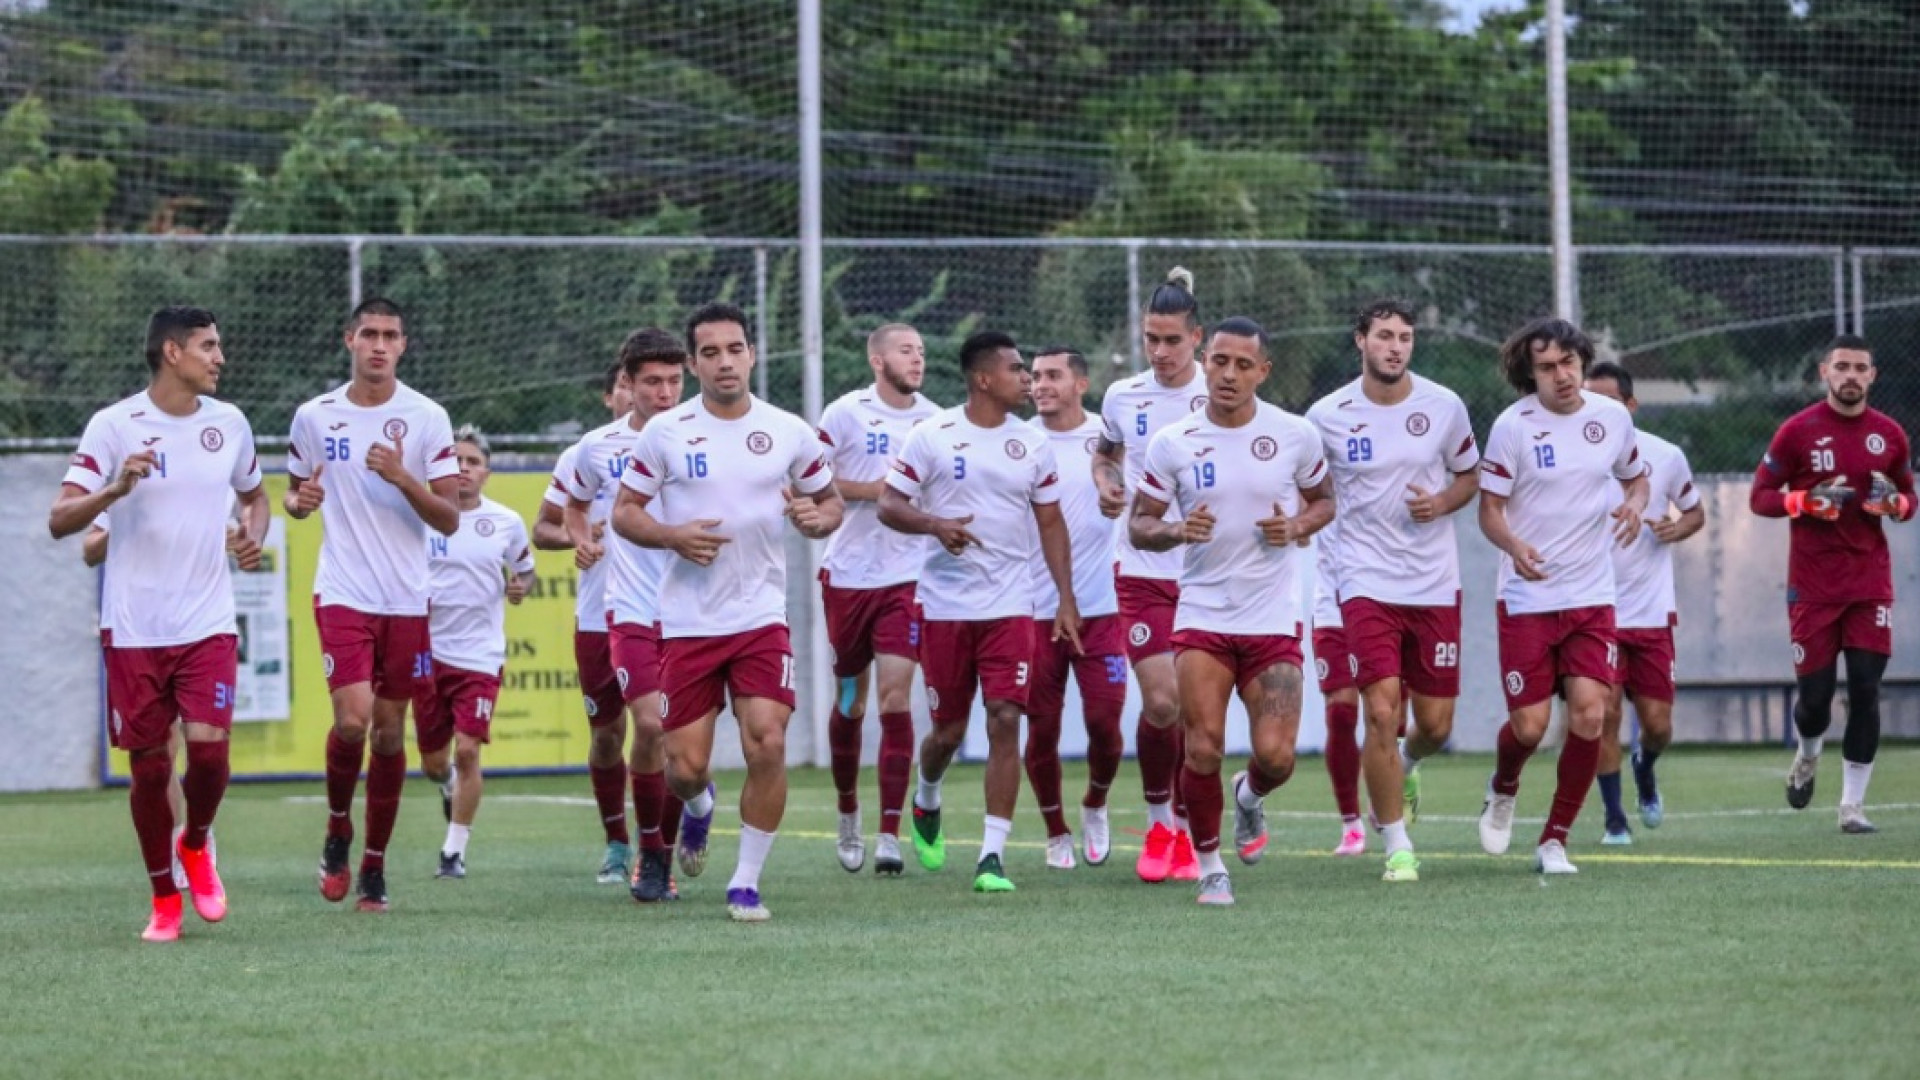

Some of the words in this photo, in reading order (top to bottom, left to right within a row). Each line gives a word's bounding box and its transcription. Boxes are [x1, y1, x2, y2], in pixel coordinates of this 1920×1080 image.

[1136, 413, 1148, 436] 5
[325, 437, 350, 462] 36
[867, 433, 889, 455] 32
[1347, 437, 1373, 462] 29
[685, 452, 708, 478] 16
[954, 456, 966, 480] 3
[1534, 444, 1556, 469] 12
[1811, 450, 1835, 472] 30
[1193, 461, 1216, 490] 19
[430, 537, 447, 558] 14
[1434, 642, 1458, 667] 29
[1015, 662, 1028, 686] 3
